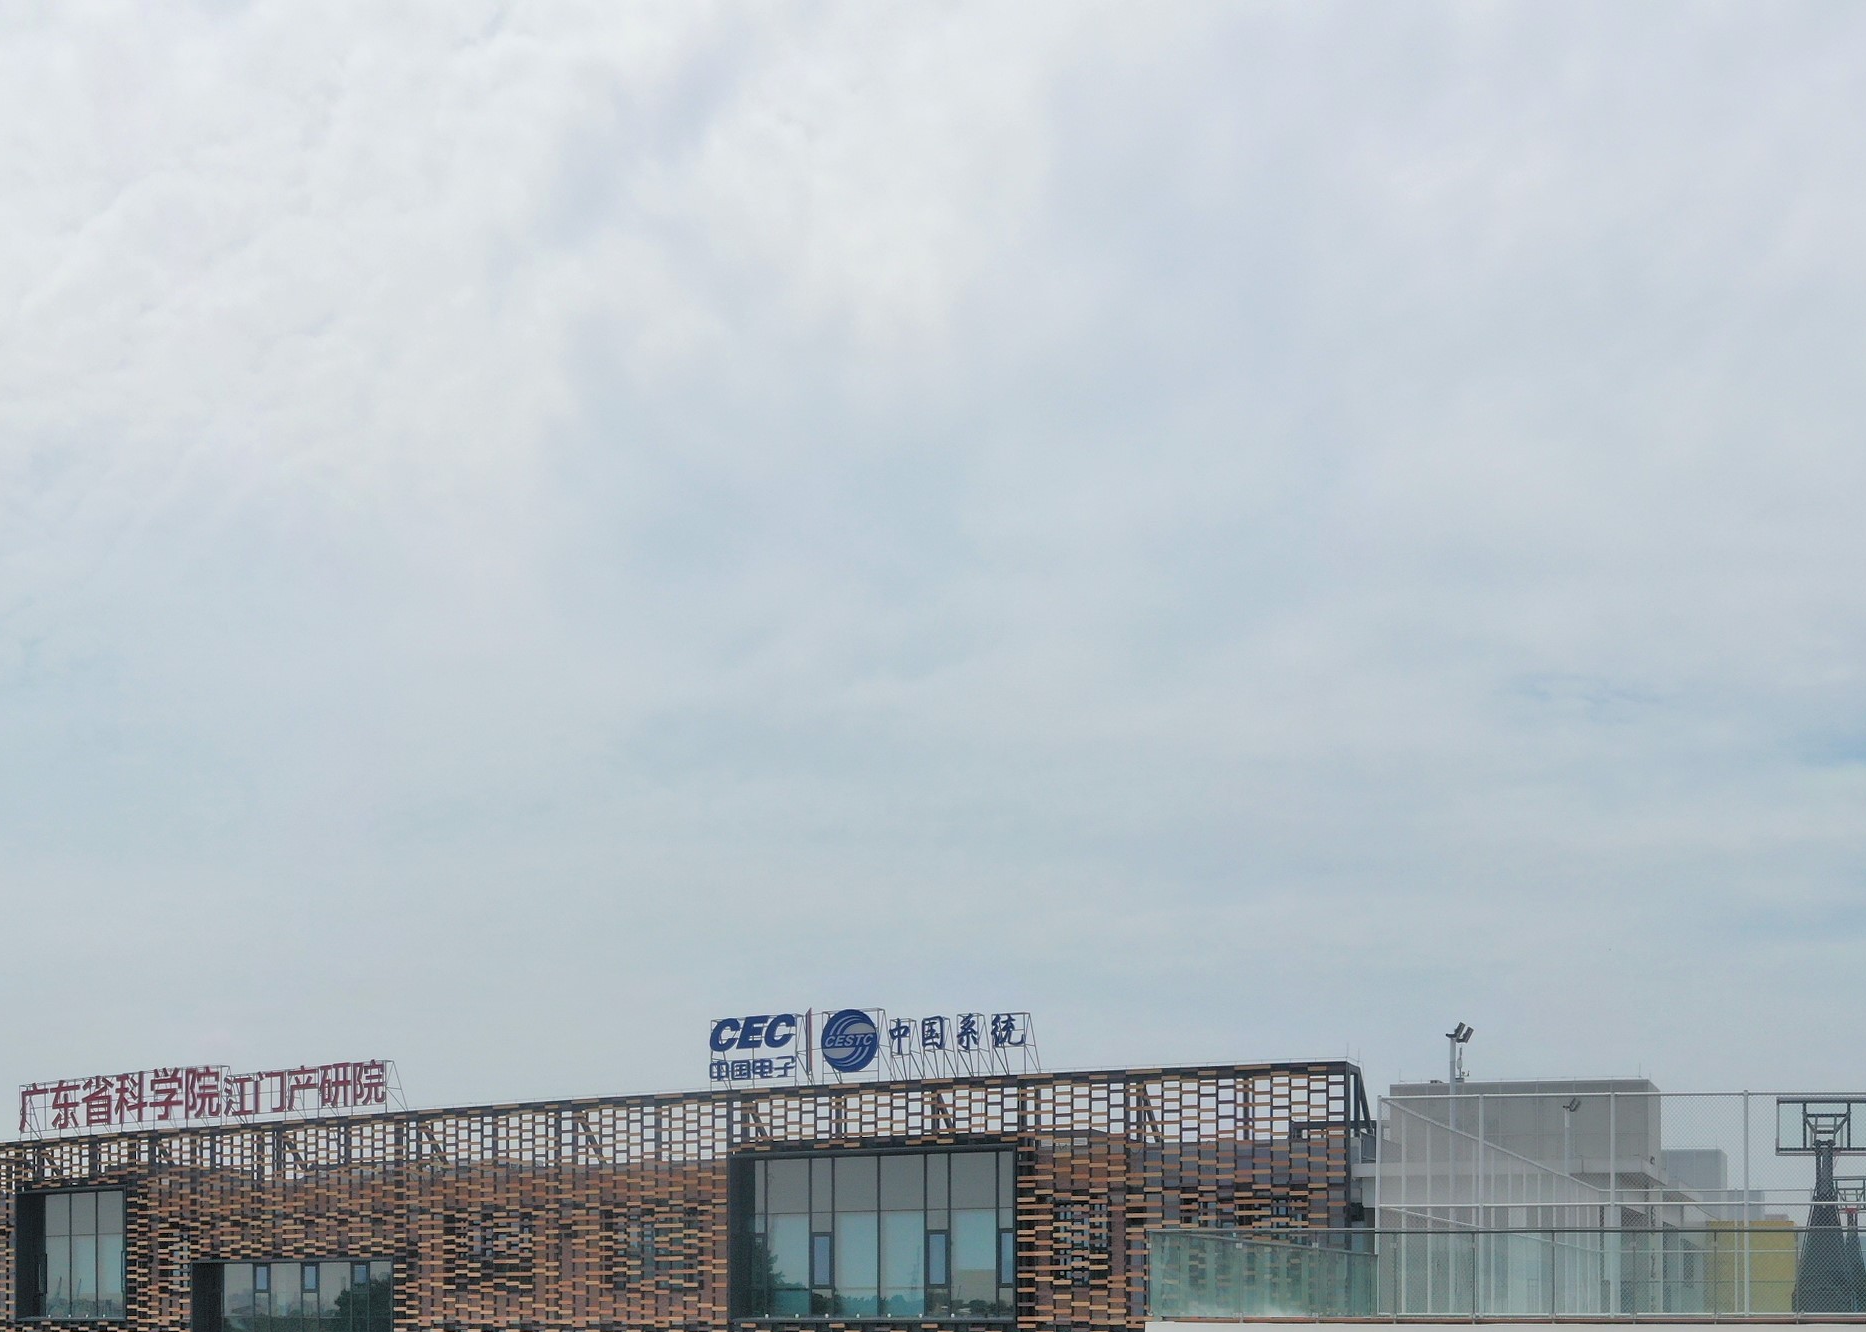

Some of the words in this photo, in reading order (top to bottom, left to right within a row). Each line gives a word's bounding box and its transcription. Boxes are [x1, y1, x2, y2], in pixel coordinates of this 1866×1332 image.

[709, 1013, 796, 1052] CEC
[824, 1033, 873, 1048] CESTC
[889, 1013, 1026, 1055] 中国系统
[709, 1055, 797, 1081] 中国电子
